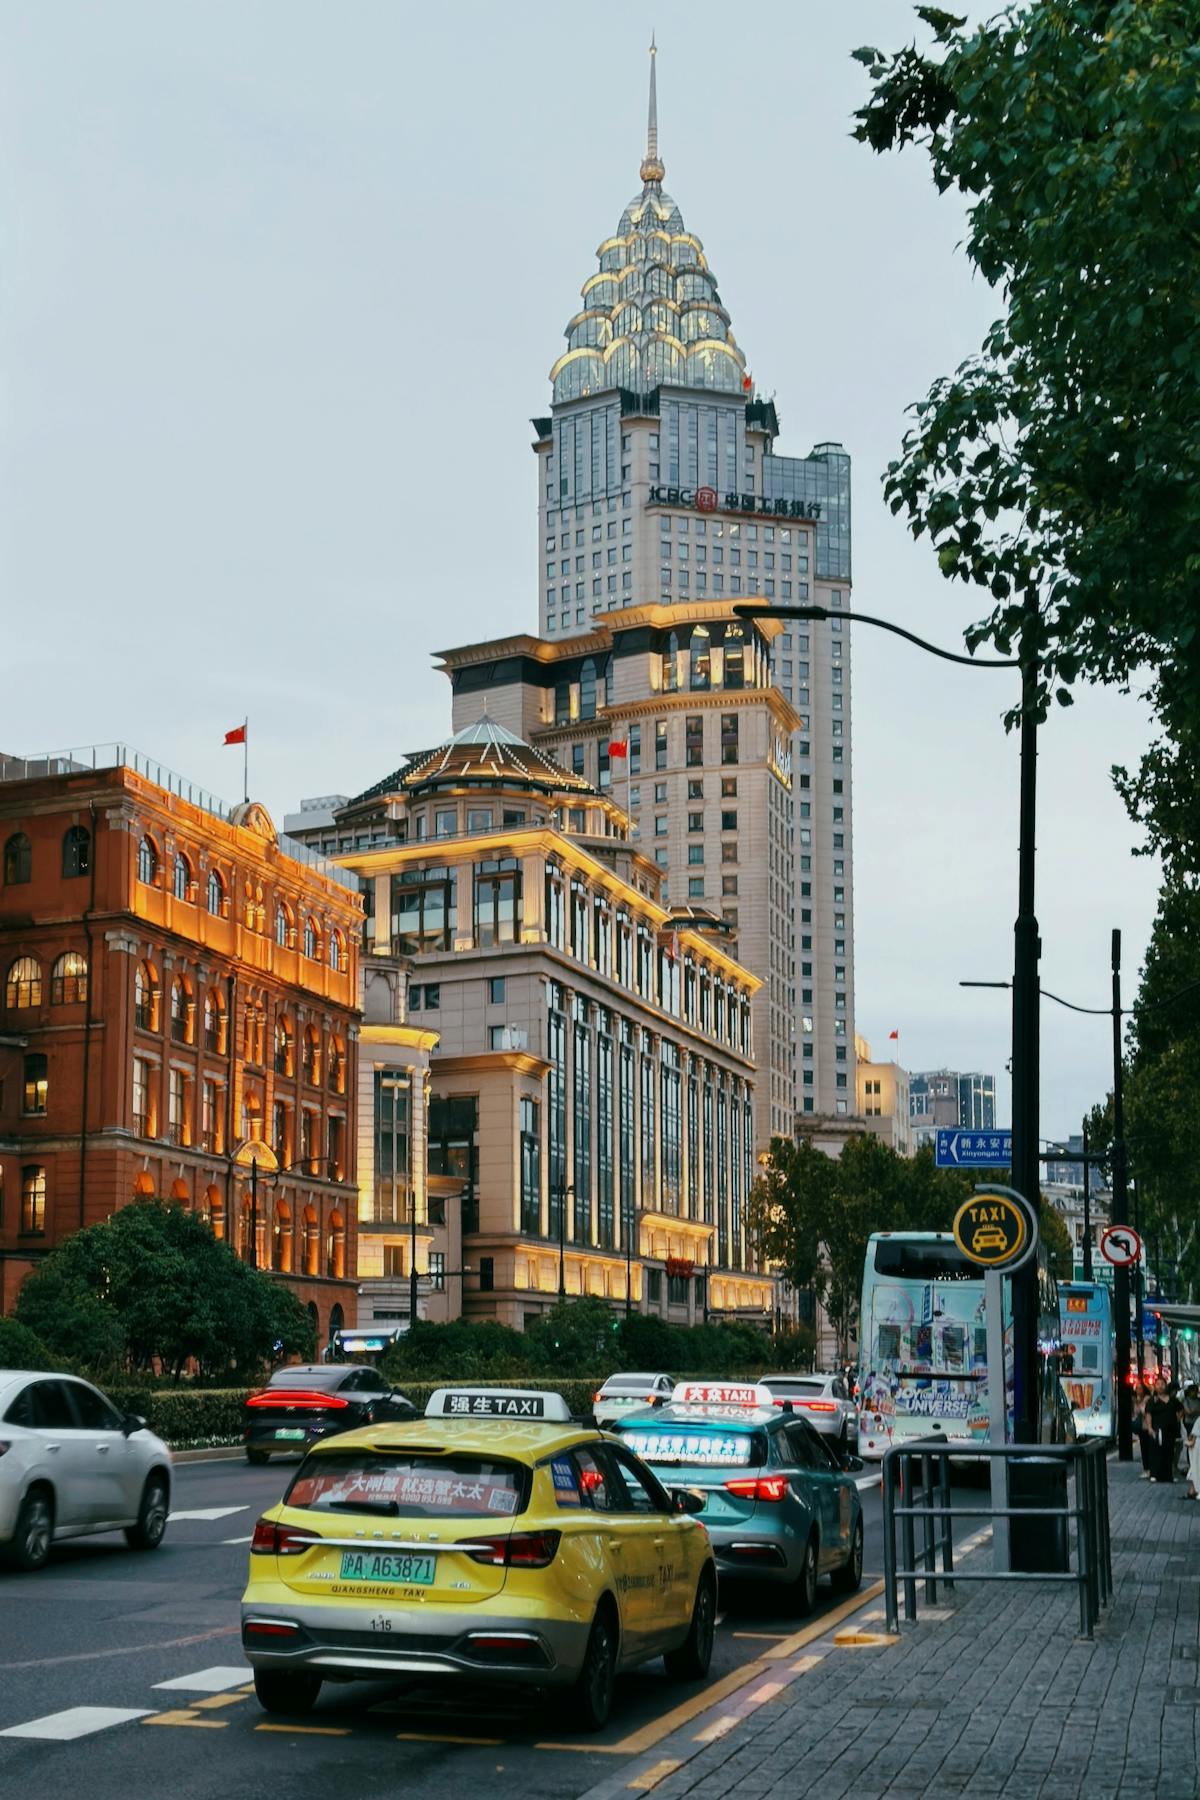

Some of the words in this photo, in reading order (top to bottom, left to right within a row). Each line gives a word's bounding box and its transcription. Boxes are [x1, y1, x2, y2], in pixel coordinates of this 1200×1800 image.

[725, 492, 822, 519] 中国工商银行
[969, 1206, 1006, 1223] TAXI
[495, 1399, 538, 1415] TAXI
[905, 1400, 969, 1414] UNIVERSE
[371, 1555, 431, 1580] A63871
[331, 1585, 395, 1595] QIANGSHENG
[403, 1589, 425, 1597] TAXI
